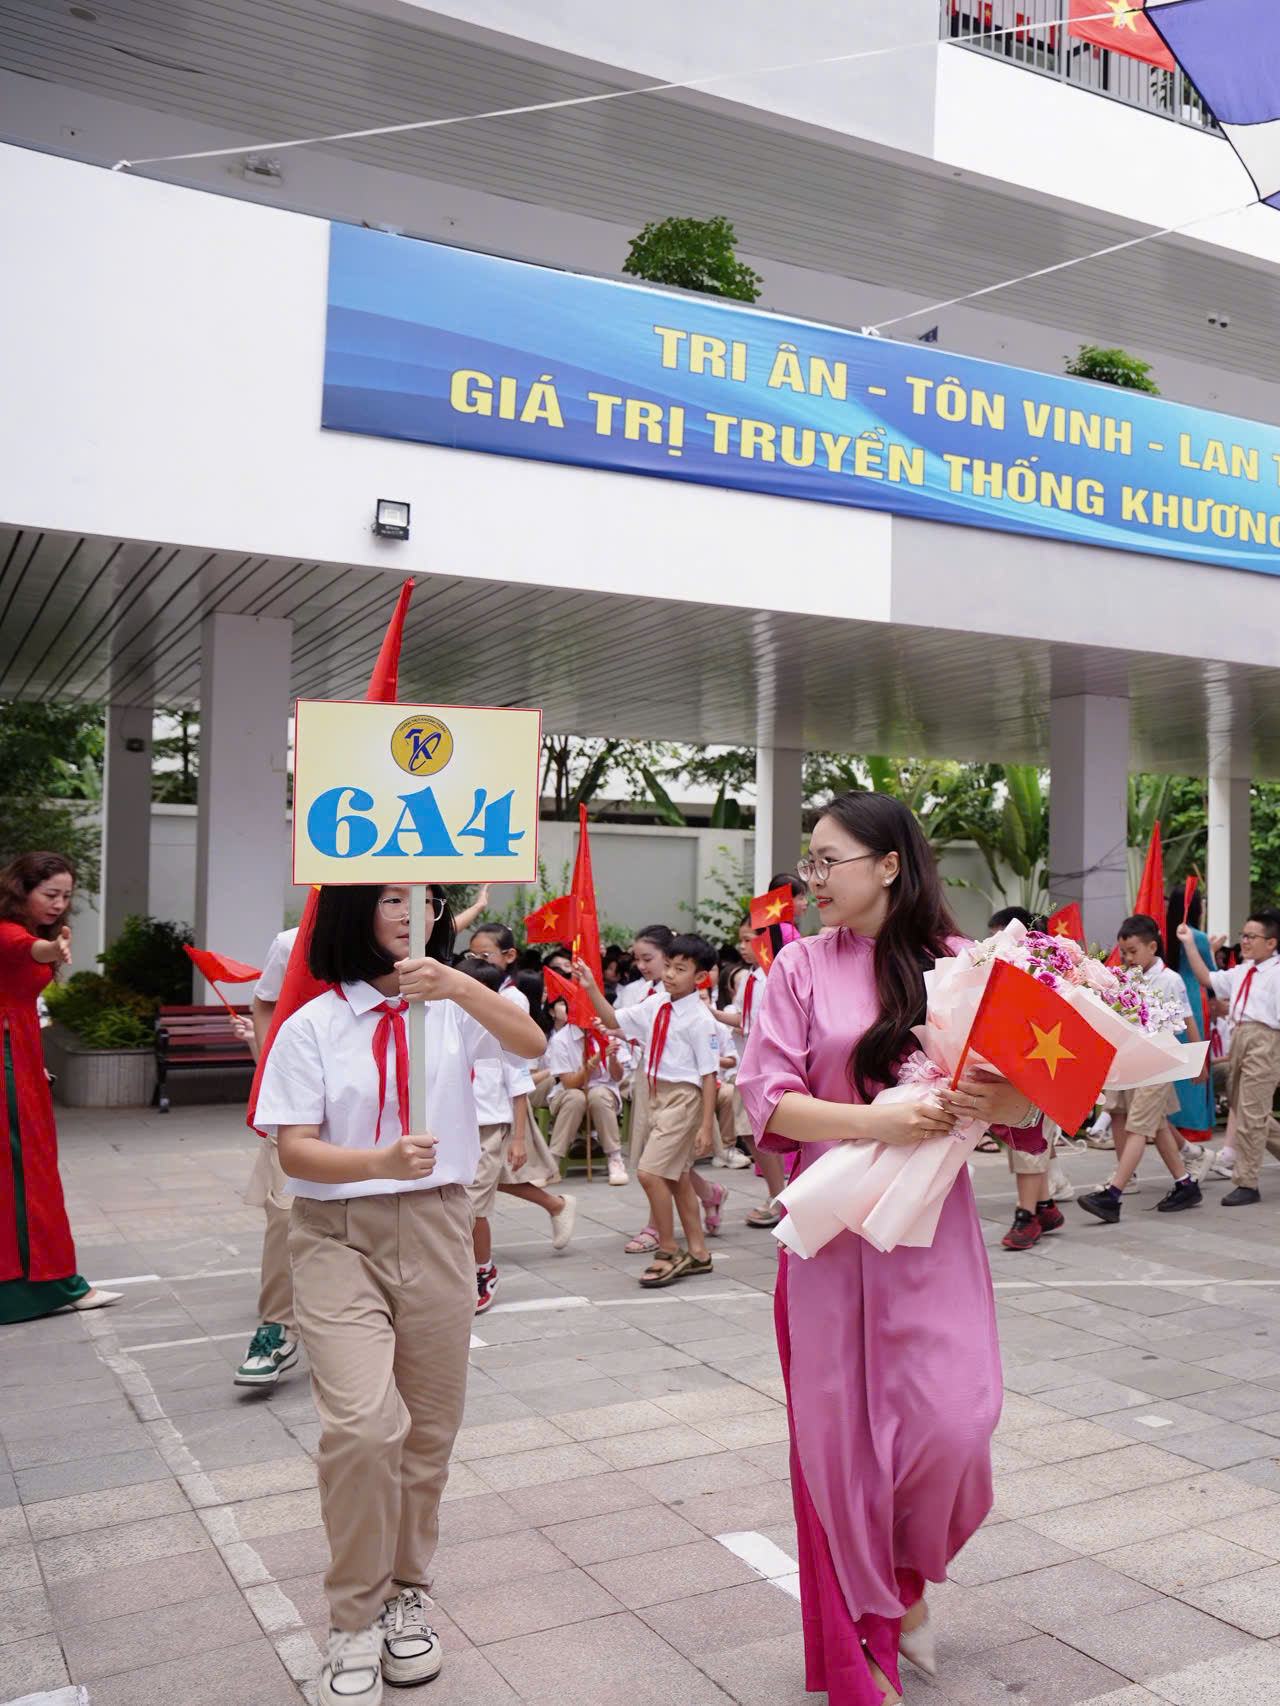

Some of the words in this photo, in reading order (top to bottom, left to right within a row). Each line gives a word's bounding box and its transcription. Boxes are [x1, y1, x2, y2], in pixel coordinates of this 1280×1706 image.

[449, 369, 565, 428] GIÁ
[587, 391, 685, 457] TRỊ
[705, 412, 925, 486] TRUYỀN
[942, 453, 1105, 516] THỐNG
[653, 326, 747, 382] TRI
[766, 342, 848, 400] ÂN
[867, 386, 887, 396] -
[905, 375, 1005, 431] TÔN
[1022, 399, 1133, 456] VINH
[1179, 434, 1260, 482] LAN
[307, 786, 526, 858] 6A4
